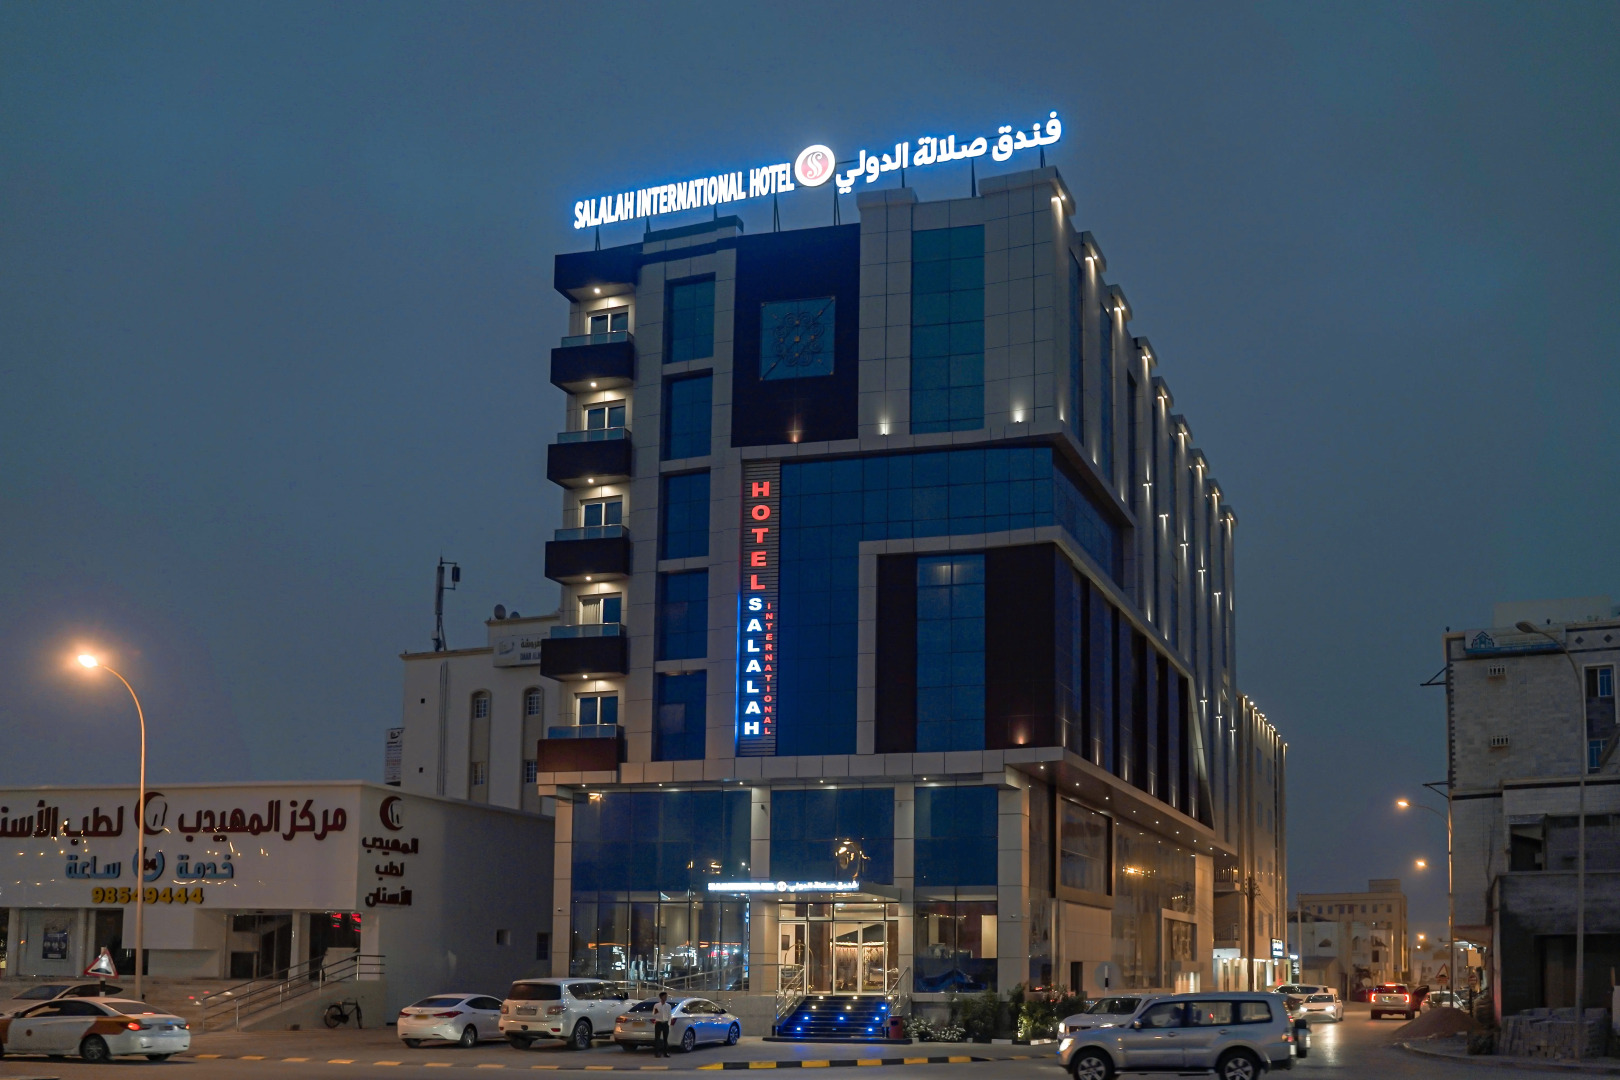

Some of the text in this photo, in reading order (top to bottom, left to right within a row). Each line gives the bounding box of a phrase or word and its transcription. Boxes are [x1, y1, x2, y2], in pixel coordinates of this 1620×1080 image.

[835, 111, 1062, 194] فندق صلالة الدولي
[573, 162, 795, 229] SALALAH INTERNATIONAL HOTEL
[750, 481, 771, 590] HOTEL
[744, 597, 762, 735] SALALAH
[763, 602, 774, 735] INTERNATIONAL
[0, 800, 347, 846] مركز المهيدب لطب الأسن
[362, 837, 419, 855] المهيدب
[65, 854, 121, 879] ساعة
[176, 854, 234, 879] خدمة
[375, 861, 404, 880] لطب
